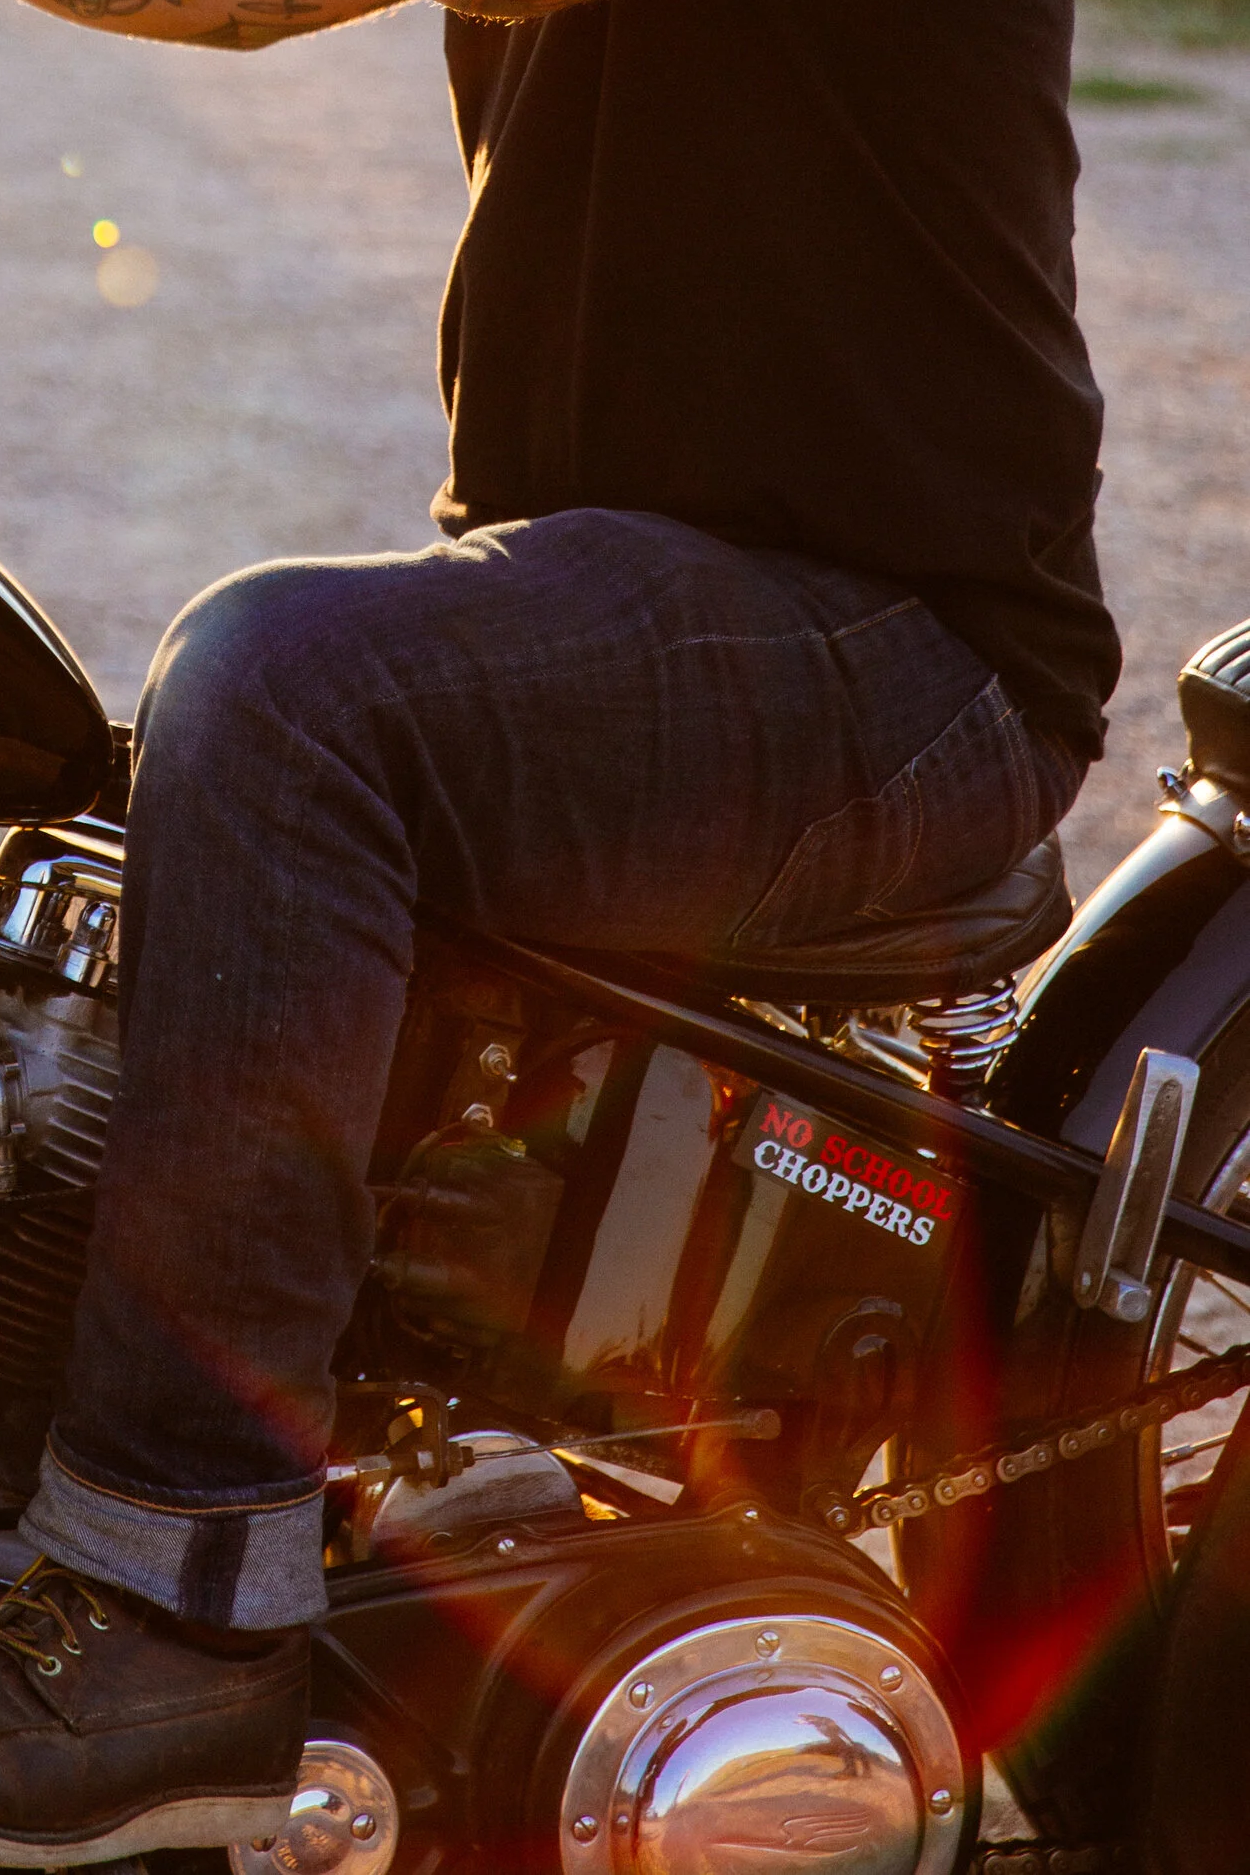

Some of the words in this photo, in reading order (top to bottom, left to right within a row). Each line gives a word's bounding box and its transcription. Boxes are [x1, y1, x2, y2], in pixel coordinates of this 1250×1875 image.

[754, 1140, 935, 1246] CHOPPERS
[759, 1103, 813, 1148] NO
[820, 1135, 952, 1221] SCHOOL
